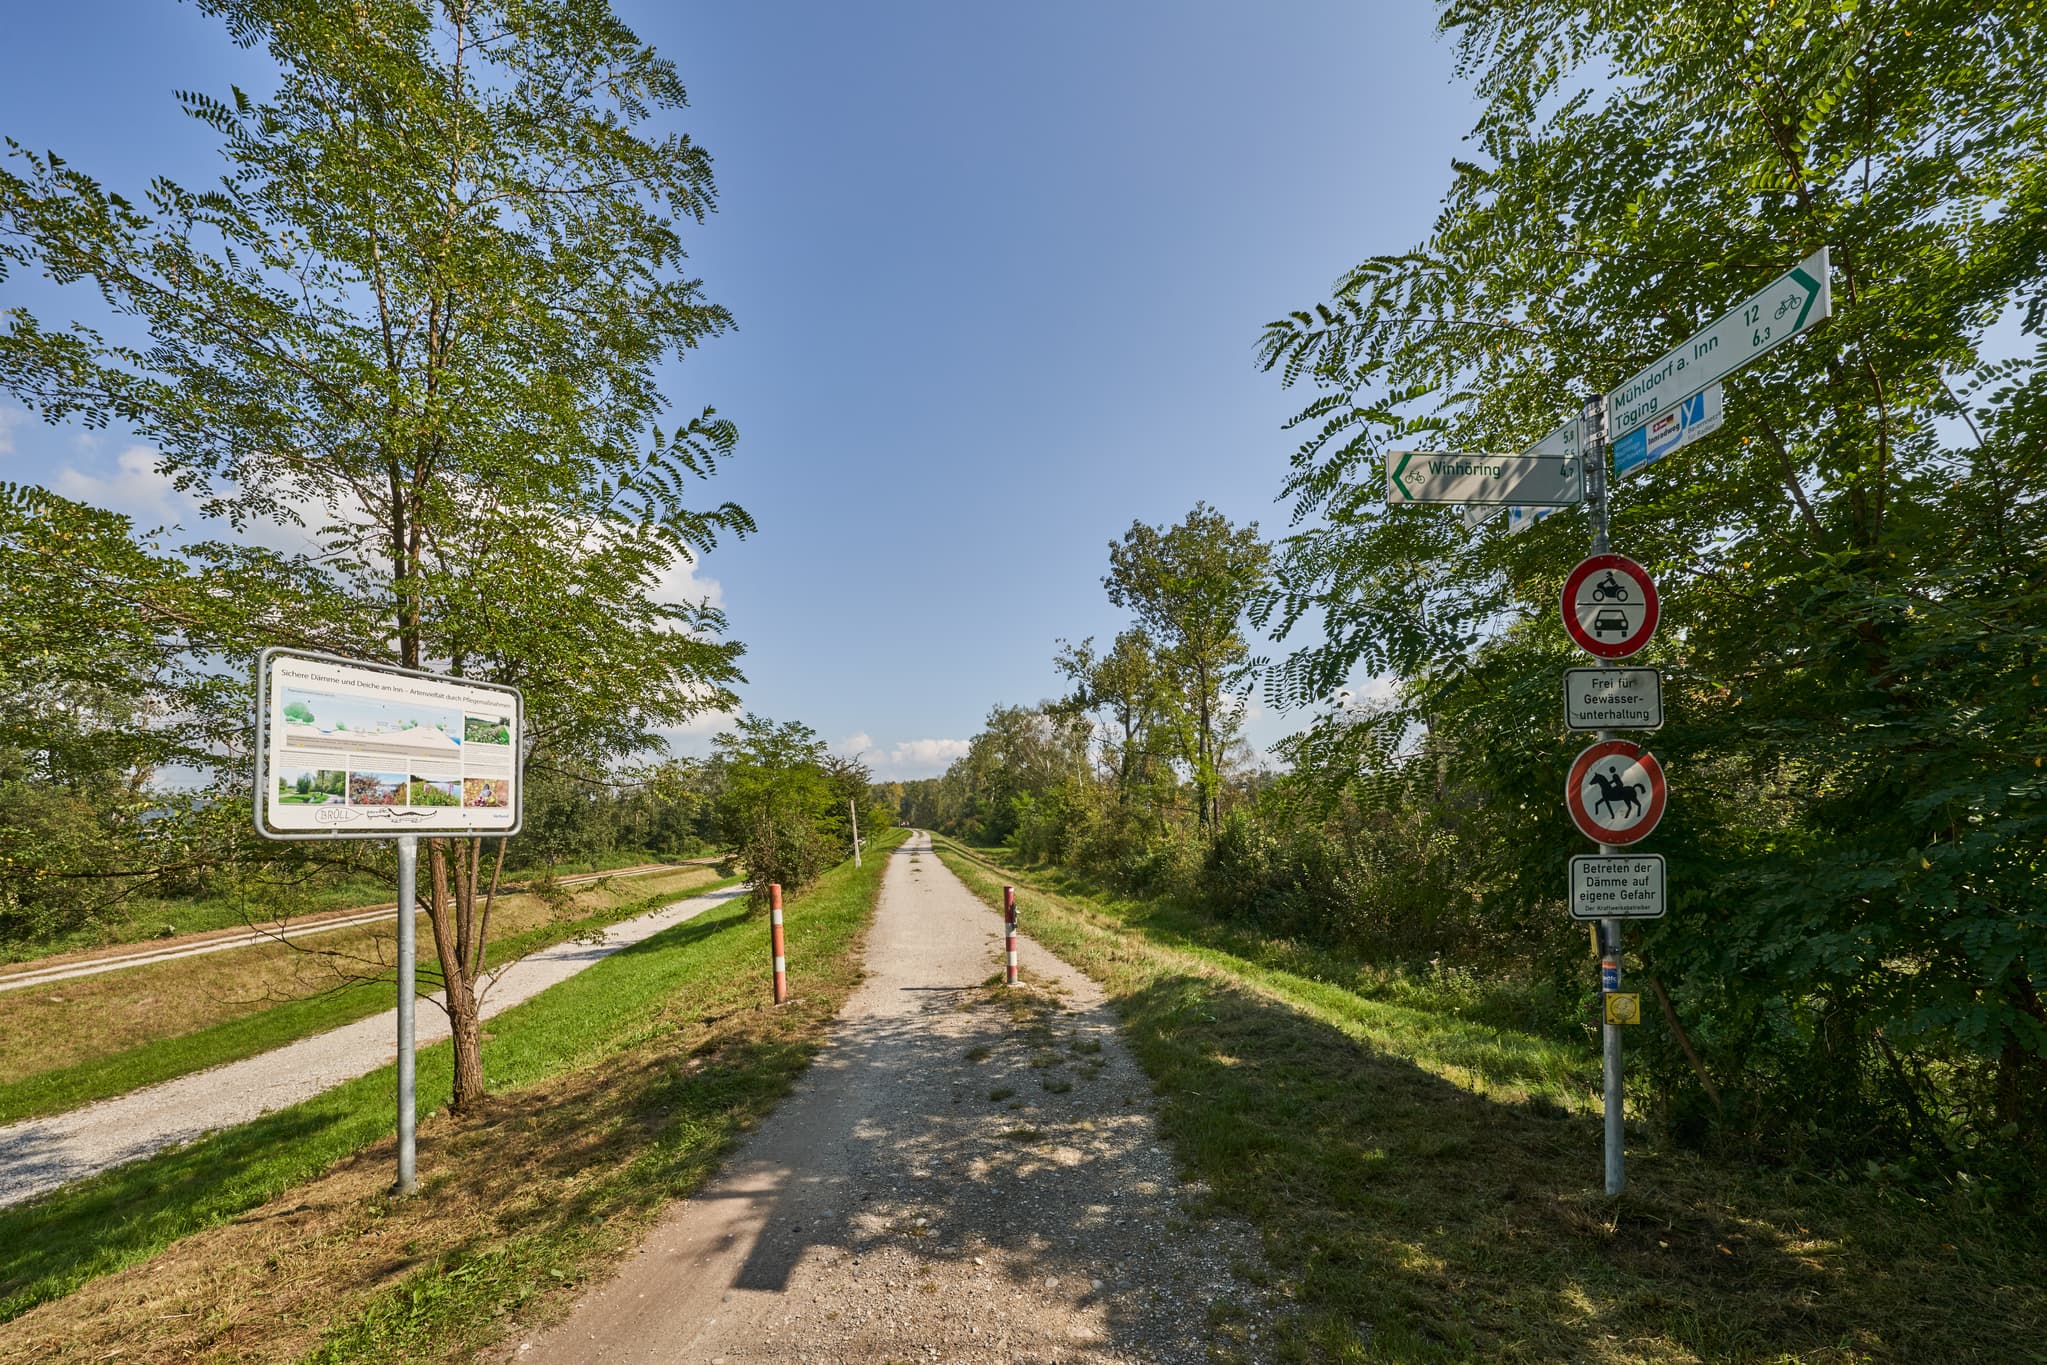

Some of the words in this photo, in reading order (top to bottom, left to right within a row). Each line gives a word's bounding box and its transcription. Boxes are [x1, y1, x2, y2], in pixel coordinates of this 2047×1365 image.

[1744, 304, 1760, 327] 12
[1615, 361, 1673, 411] Mühldorf
[1677, 358, 1689, 370] a.
[1693, 336, 1718, 360] Inn
[1615, 397, 1658, 430] Töging
[1648, 424, 1680, 445] Innradweg
[1428, 461, 1501, 480] Winhöring
[281, 669, 309, 680] Sichere
[311, 673, 340, 684] Dämme
[341, 679, 355, 687] und
[356, 680, 380, 691] Deiche
[410, 688, 445, 700] Artenvielfalt
[1592, 678, 1613, 689] Frei
[1618, 677, 1633, 689] für
[1584, 694, 1644, 705] Gewässer-
[1580, 709, 1649, 721] unterhaltung
[320, 808, 350, 820] BRÜLL
[1583, 863, 1630, 873] Betreten
[1634, 862, 1653, 873] der
[1586, 876, 1628, 887] Dämme
[1632, 876, 1649, 887] auf
[1580, 890, 1616, 903] eigene
[1620, 890, 1656, 901] Gefahr
